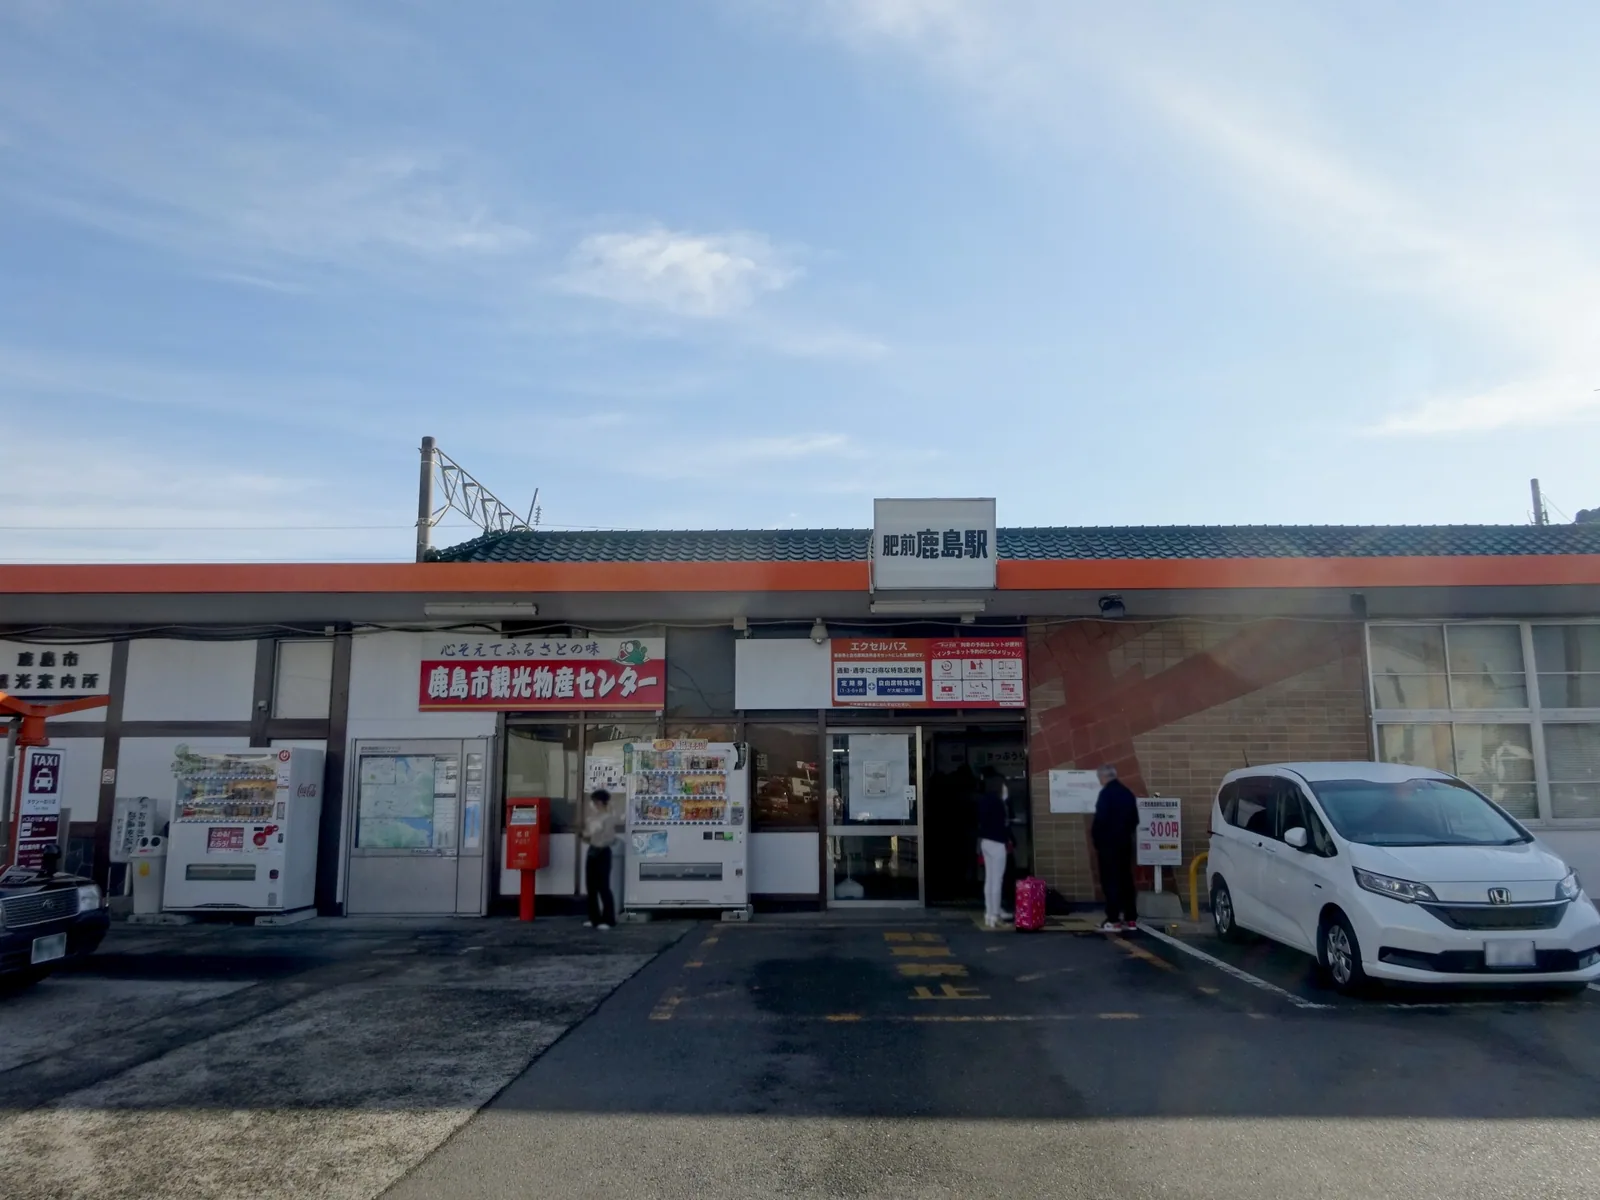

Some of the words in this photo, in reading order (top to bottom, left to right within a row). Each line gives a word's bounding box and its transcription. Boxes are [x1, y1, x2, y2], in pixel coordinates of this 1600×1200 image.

[882, 528, 988, 559] 肥前鹿島駅
[440, 641, 601, 657] 心そえてふるさとの味
[17, 650, 79, 667] 鹿島市
[427, 665, 658, 701] 鹿島市観光物産センター
[33, 754, 58, 767] TAXI
[1150, 821, 1179, 838] 300円
